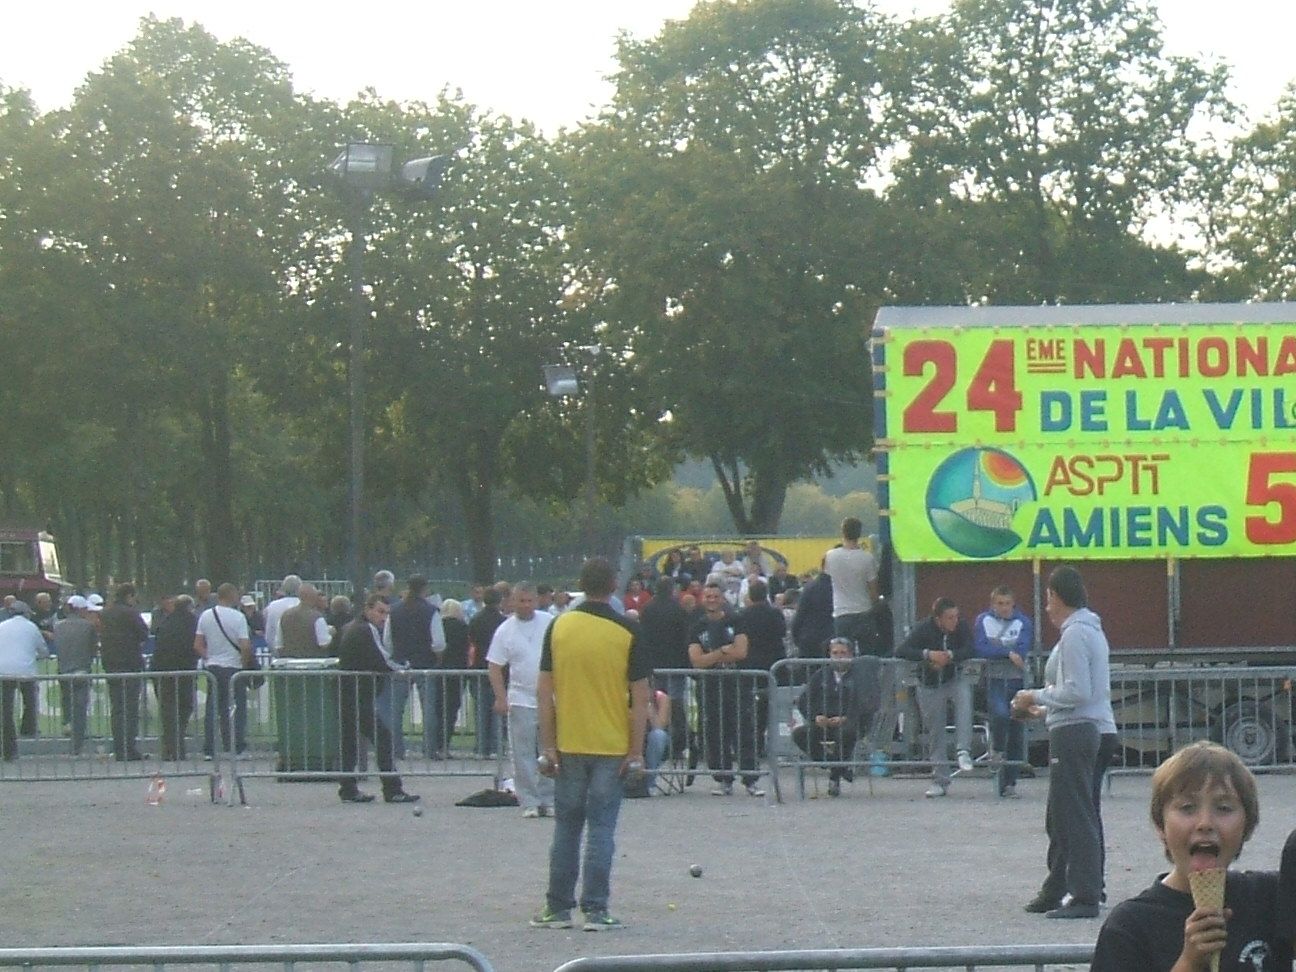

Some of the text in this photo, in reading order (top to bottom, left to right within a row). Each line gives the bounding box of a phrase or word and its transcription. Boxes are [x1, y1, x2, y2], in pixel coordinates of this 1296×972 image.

[902, 338, 1023, 434] 24
[1039, 389, 1109, 433] DE
[1125, 388, 1191, 432] LA
[1043, 453, 1171, 497] ASPTT
[1028, 505, 1229, 549] AMIENS
